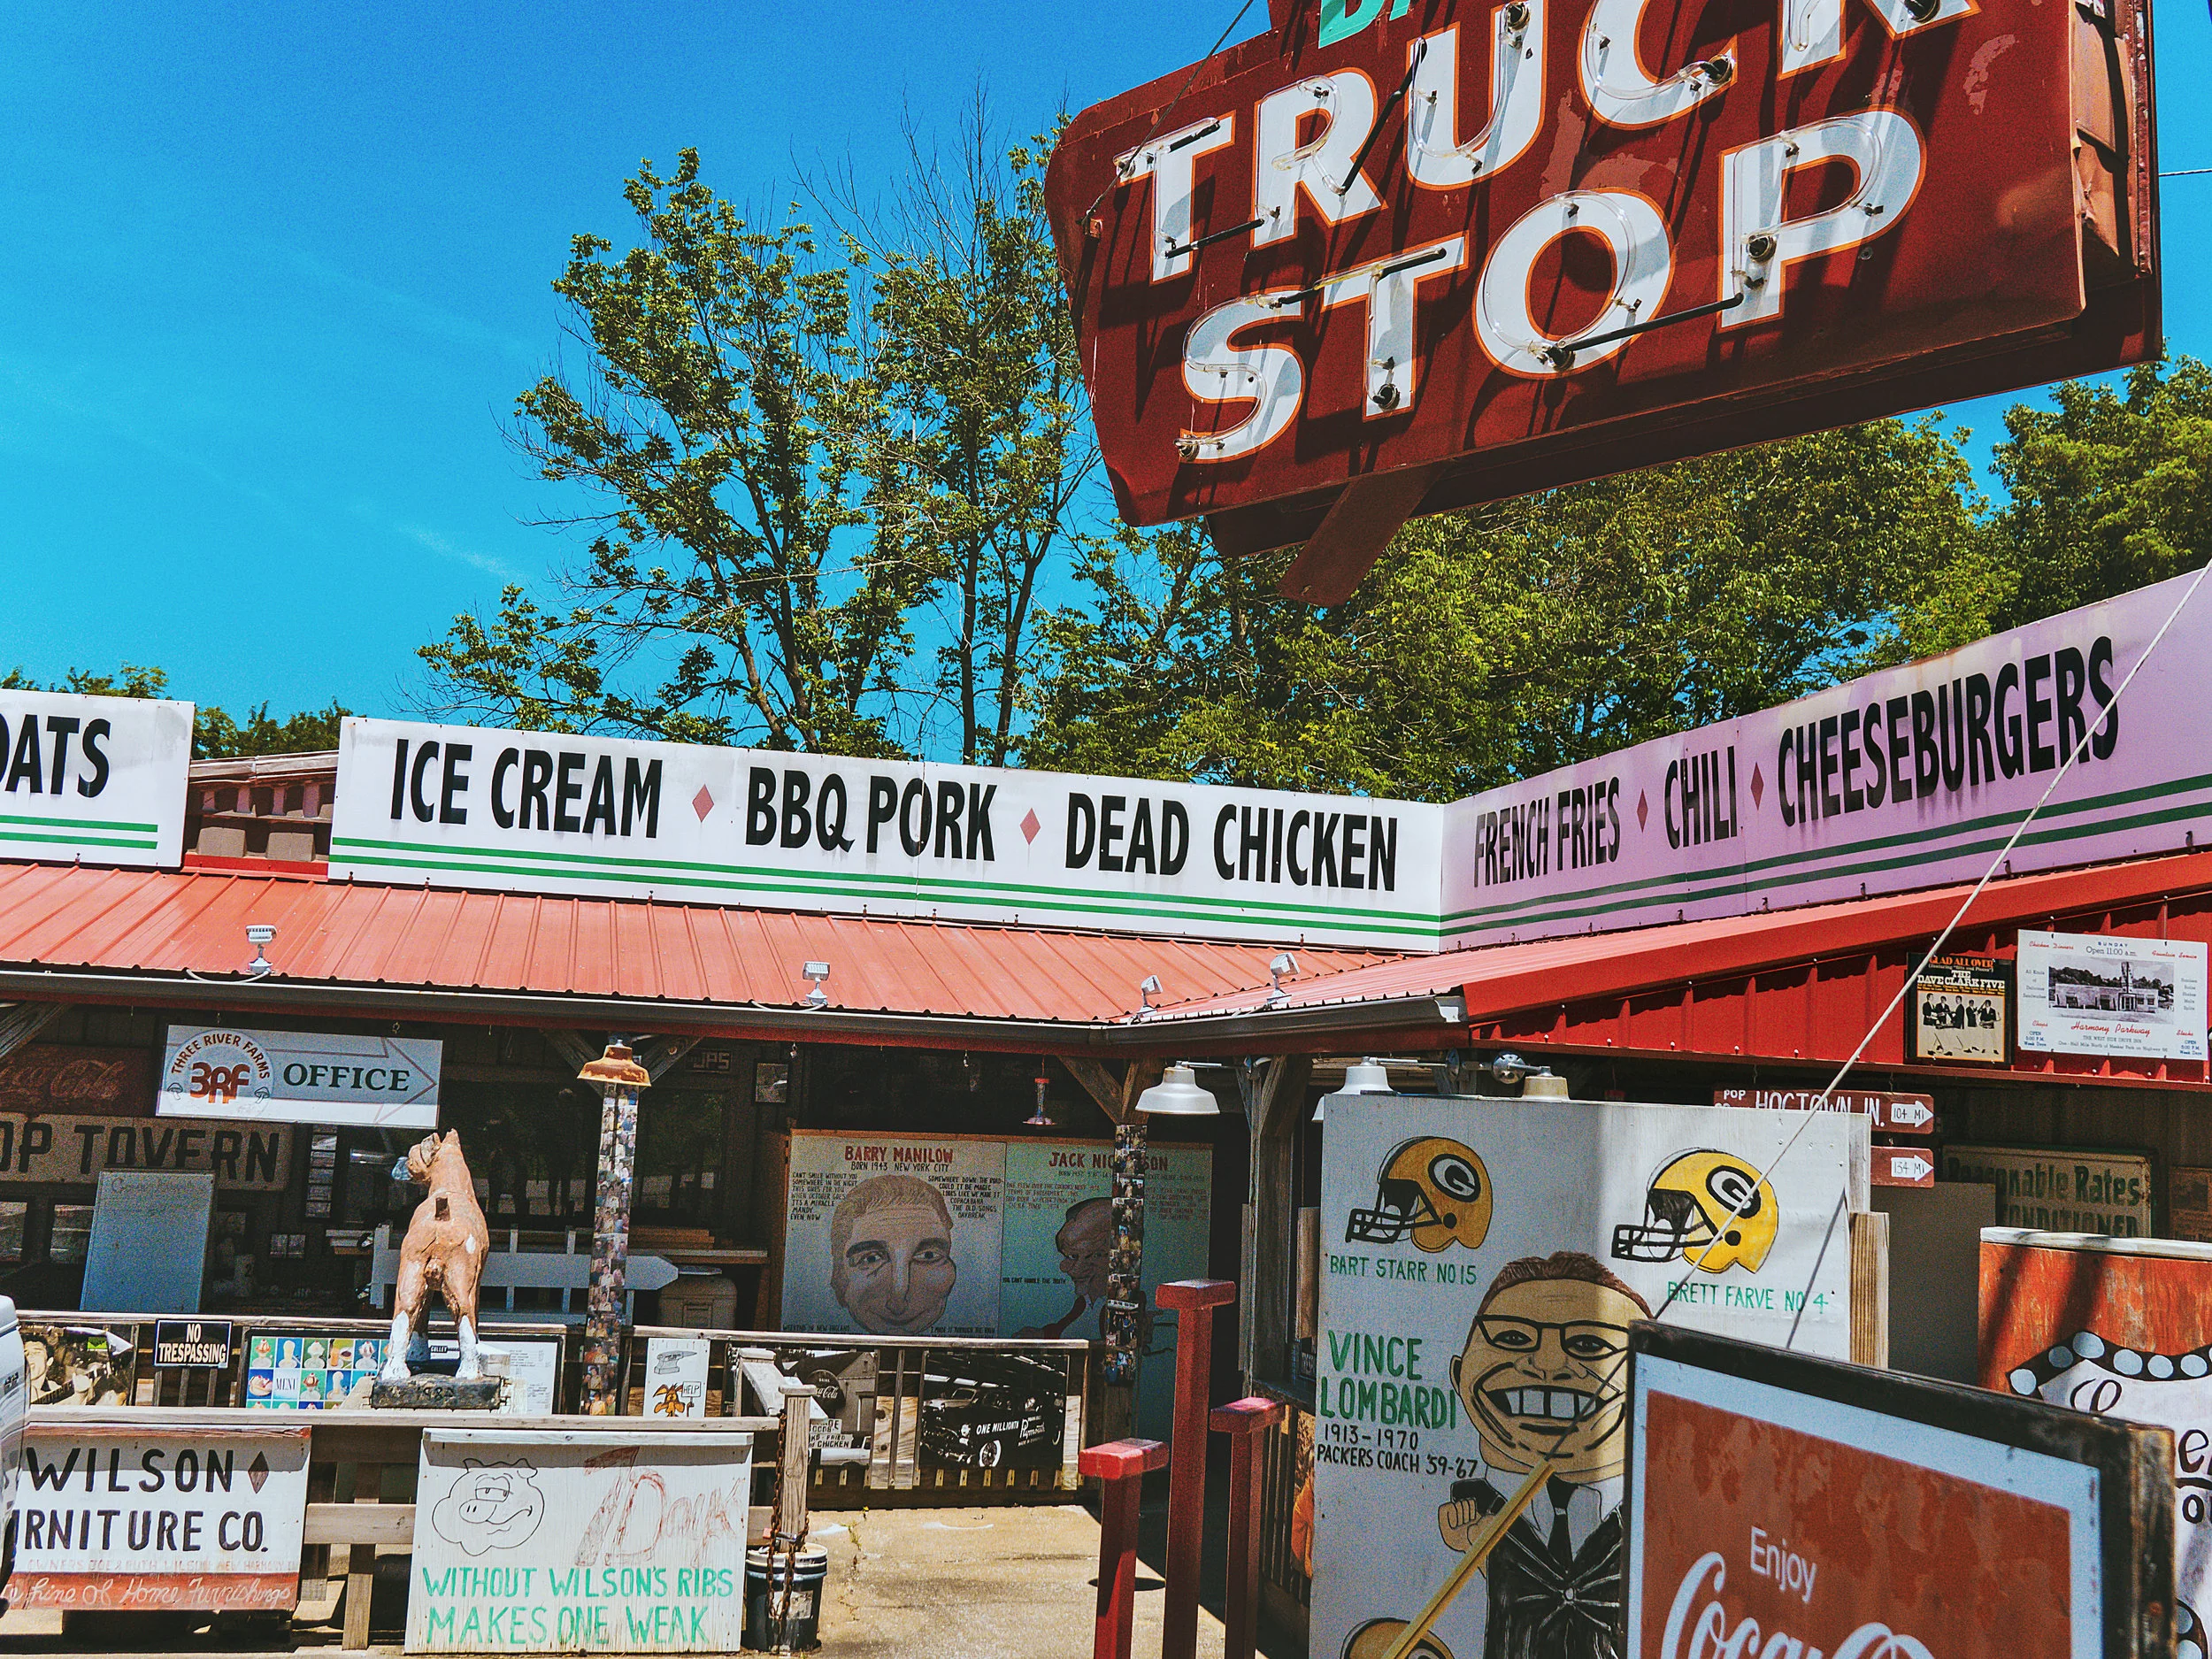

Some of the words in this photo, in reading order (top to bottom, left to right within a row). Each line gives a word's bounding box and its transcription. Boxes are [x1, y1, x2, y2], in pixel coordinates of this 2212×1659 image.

[1177, 105, 1926, 465] STOP
[1472, 799, 1549, 888] FRENCH
[1556, 775, 1621, 872] FRIES
[1663, 744, 1739, 850] CHILI
[1777, 634, 2120, 828] CHEESEBURGERS
[390, 738, 472, 826] ICE
[490, 747, 664, 840] CREAM
[745, 765, 855, 855] BBQ
[866, 775, 998, 863] PORK
[1066, 791, 1191, 877] DEAD
[1213, 803, 1398, 893] CHICKEN
[1929, 956, 1953, 965] GLAD
[1954, 958, 1969, 967] ALL
[1970, 959, 1994, 969] OVER
[2085, 946, 2105, 956] Open
[1916, 974, 1944, 985] DAVE
[1945, 977, 1979, 987] CLARK
[1980, 979, 2006, 989] FIVE
[1951, 970, 1971, 979] THE
[2070, 1021, 2110, 1034] Harmony
[2115, 1024, 2151, 1037] Parkway
[171, 1039, 202, 1075] THREE
[203, 1032, 242, 1048] RIVER
[242, 1041, 271, 1080] FARMS
[283, 1063, 411, 1092] OFFICE
[1724, 1089, 1747, 1102] POP
[1893, 1108, 1908, 1119] 104
[1914, 1110, 1924, 1121] MI
[845, 1146, 887, 1162] BARRY
[893, 1148, 954, 1164] MANILOW
[851, 1161, 868, 1171] BORN
[894, 1163, 910, 1172] NEW
[912, 1163, 930, 1172] YORK
[933, 1164, 949, 1172] CITY
[1048, 1151, 1087, 1168] JACK
[1913, 1164, 1925, 1175] MI
[2074, 1164, 2141, 1206] Rates
[1330, 1255, 1370, 1277] BART
[1376, 1259, 1428, 1281] STARR
[1667, 1280, 1719, 1305] BRETT
[1725, 1285, 1775, 1310] FARVE
[1785, 1290, 1806, 1311] NO
[1812, 1293, 1829, 1315] 4
[186, 1322, 203, 1344] NO
[157, 1341, 227, 1365] TRESPASSING
[1328, 1329, 1423, 1380] VINCE
[683, 1385, 700, 1395] HELP
[1320, 1376, 1456, 1431] LOMBARDI
[976, 1424, 991, 1435] ONE
[817, 1440, 852, 1449] CHICKEN
[26, 1447, 234, 1492] WILSON
[1317, 1443, 1374, 1468] PACKERS
[1377, 1450, 1420, 1474] COACH
[218, 1509, 269, 1553] CO.
[1751, 1525, 1817, 1602] Enjoy
[119, 1578, 182, 1606] Home
[188, 1578, 291, 1609] Furnishings
[422, 1566, 537, 1598] WITHOUT
[549, 1565, 668, 1598] WILSON'S
[677, 1567, 734, 1598] RIBS
[426, 1606, 549, 1645] MAKES
[557, 1606, 609, 1645] ONE
[626, 1606, 709, 1645] WEAK
